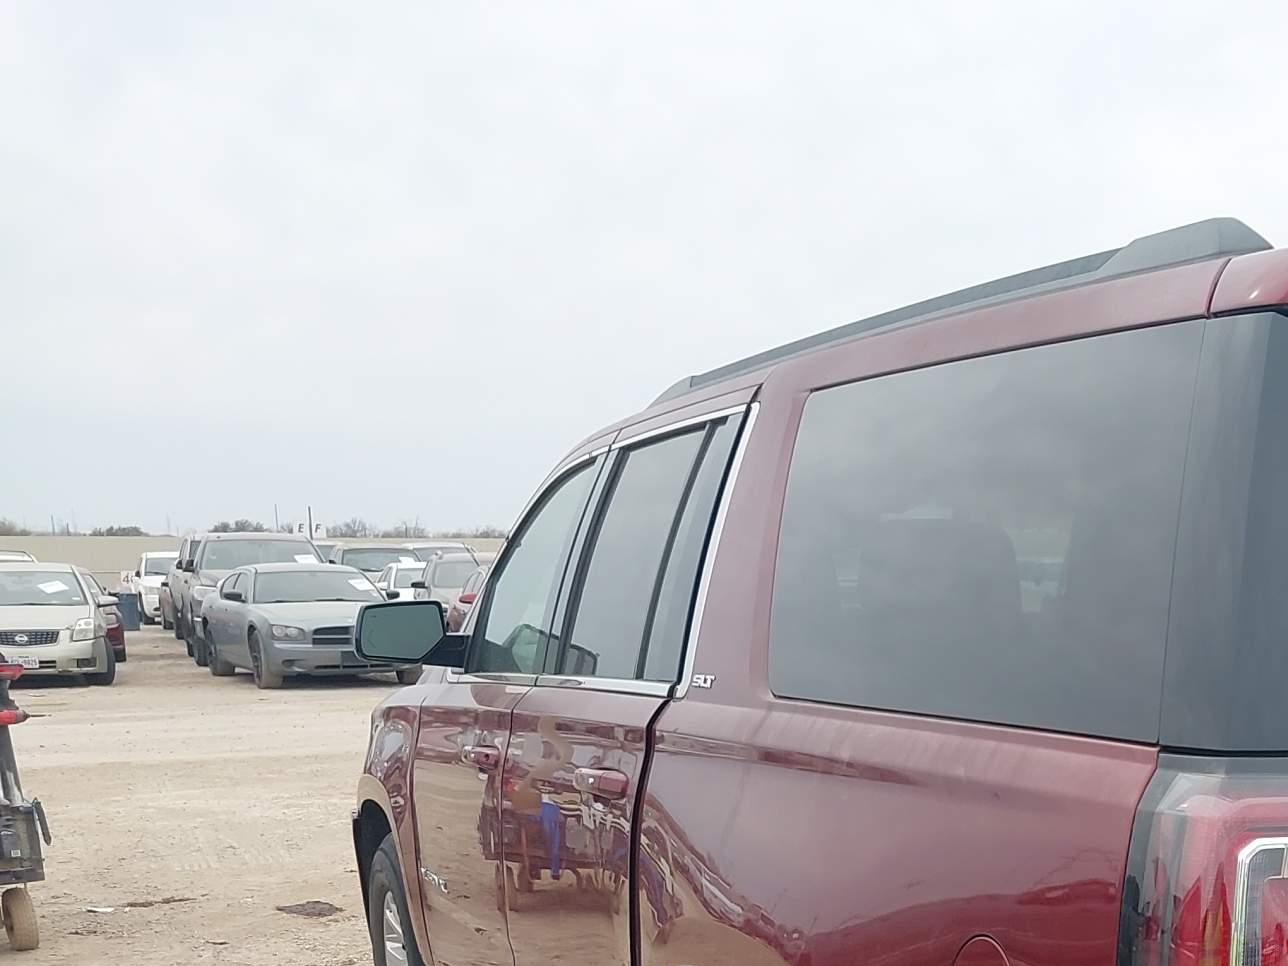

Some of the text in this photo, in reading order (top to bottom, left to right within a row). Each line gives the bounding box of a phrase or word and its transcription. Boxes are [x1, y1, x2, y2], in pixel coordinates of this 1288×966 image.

[297, 523, 305, 533] E
[314, 523, 322, 533] F
[691, 673, 716, 688] SLT
